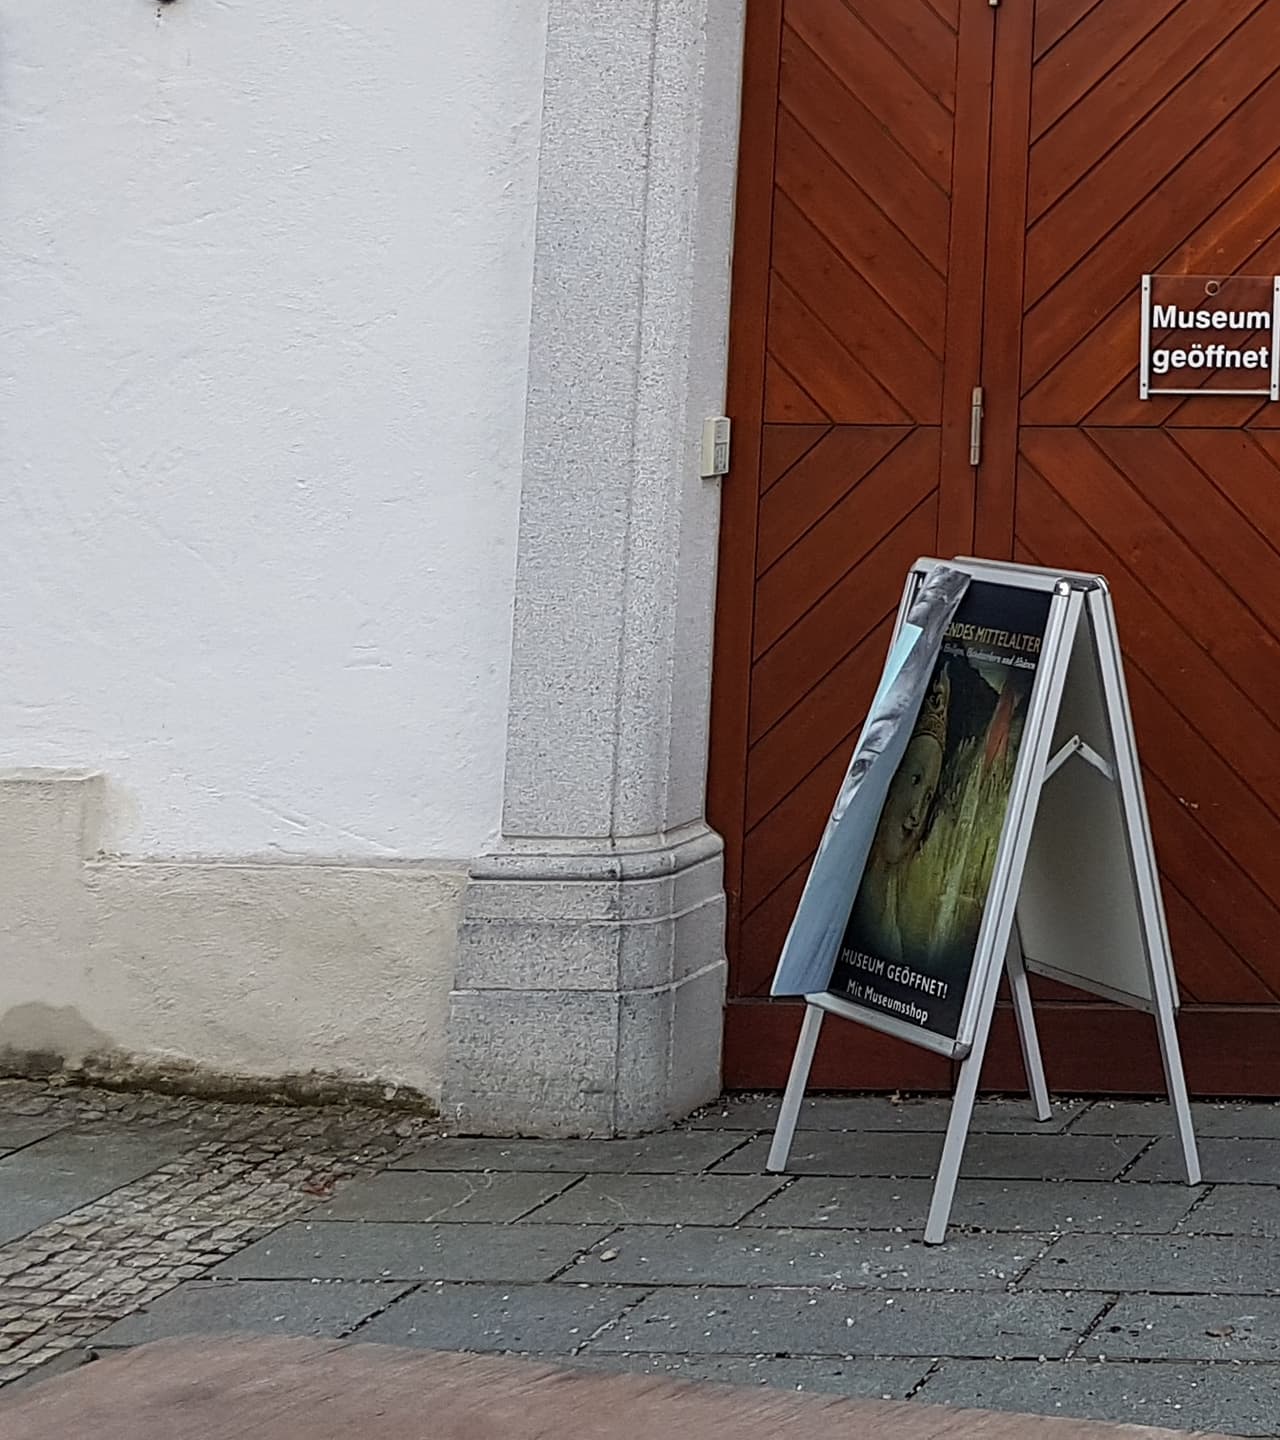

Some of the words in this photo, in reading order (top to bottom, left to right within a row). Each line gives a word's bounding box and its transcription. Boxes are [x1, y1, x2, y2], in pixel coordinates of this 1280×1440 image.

[1152, 305, 1270, 329] Museum
[1152, 344, 1269, 374] geöffnet
[976, 625, 1041, 654] MITTELALTER
[841, 947, 886, 976] MUSEUM
[886, 965, 949, 1000] GEÖFFNET!
[846, 978, 863, 998] Mit
[864, 985, 929, 1026] Museumsshop
